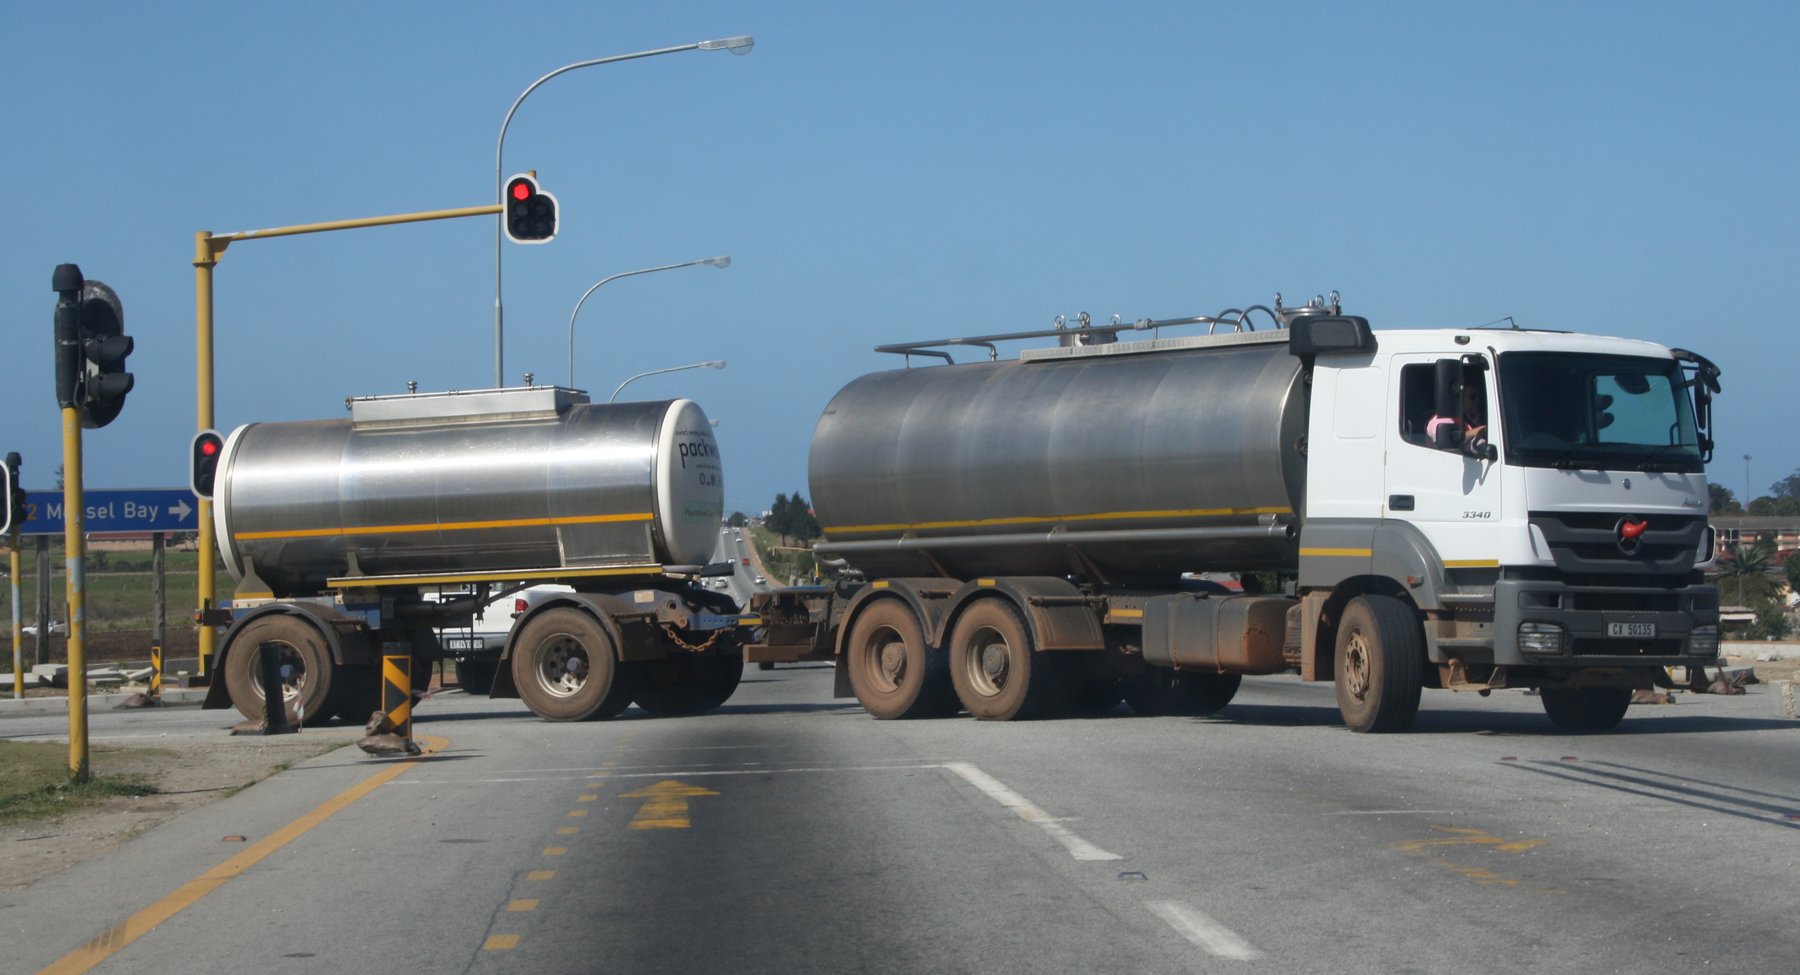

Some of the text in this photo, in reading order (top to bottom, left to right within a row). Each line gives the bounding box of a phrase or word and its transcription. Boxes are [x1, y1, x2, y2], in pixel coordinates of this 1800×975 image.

[46, 501, 115, 520] Msel
[124, 501, 159, 522] Bay
[1462, 511, 1491, 519] 3340
[1613, 623, 1652, 635] CX 50135
